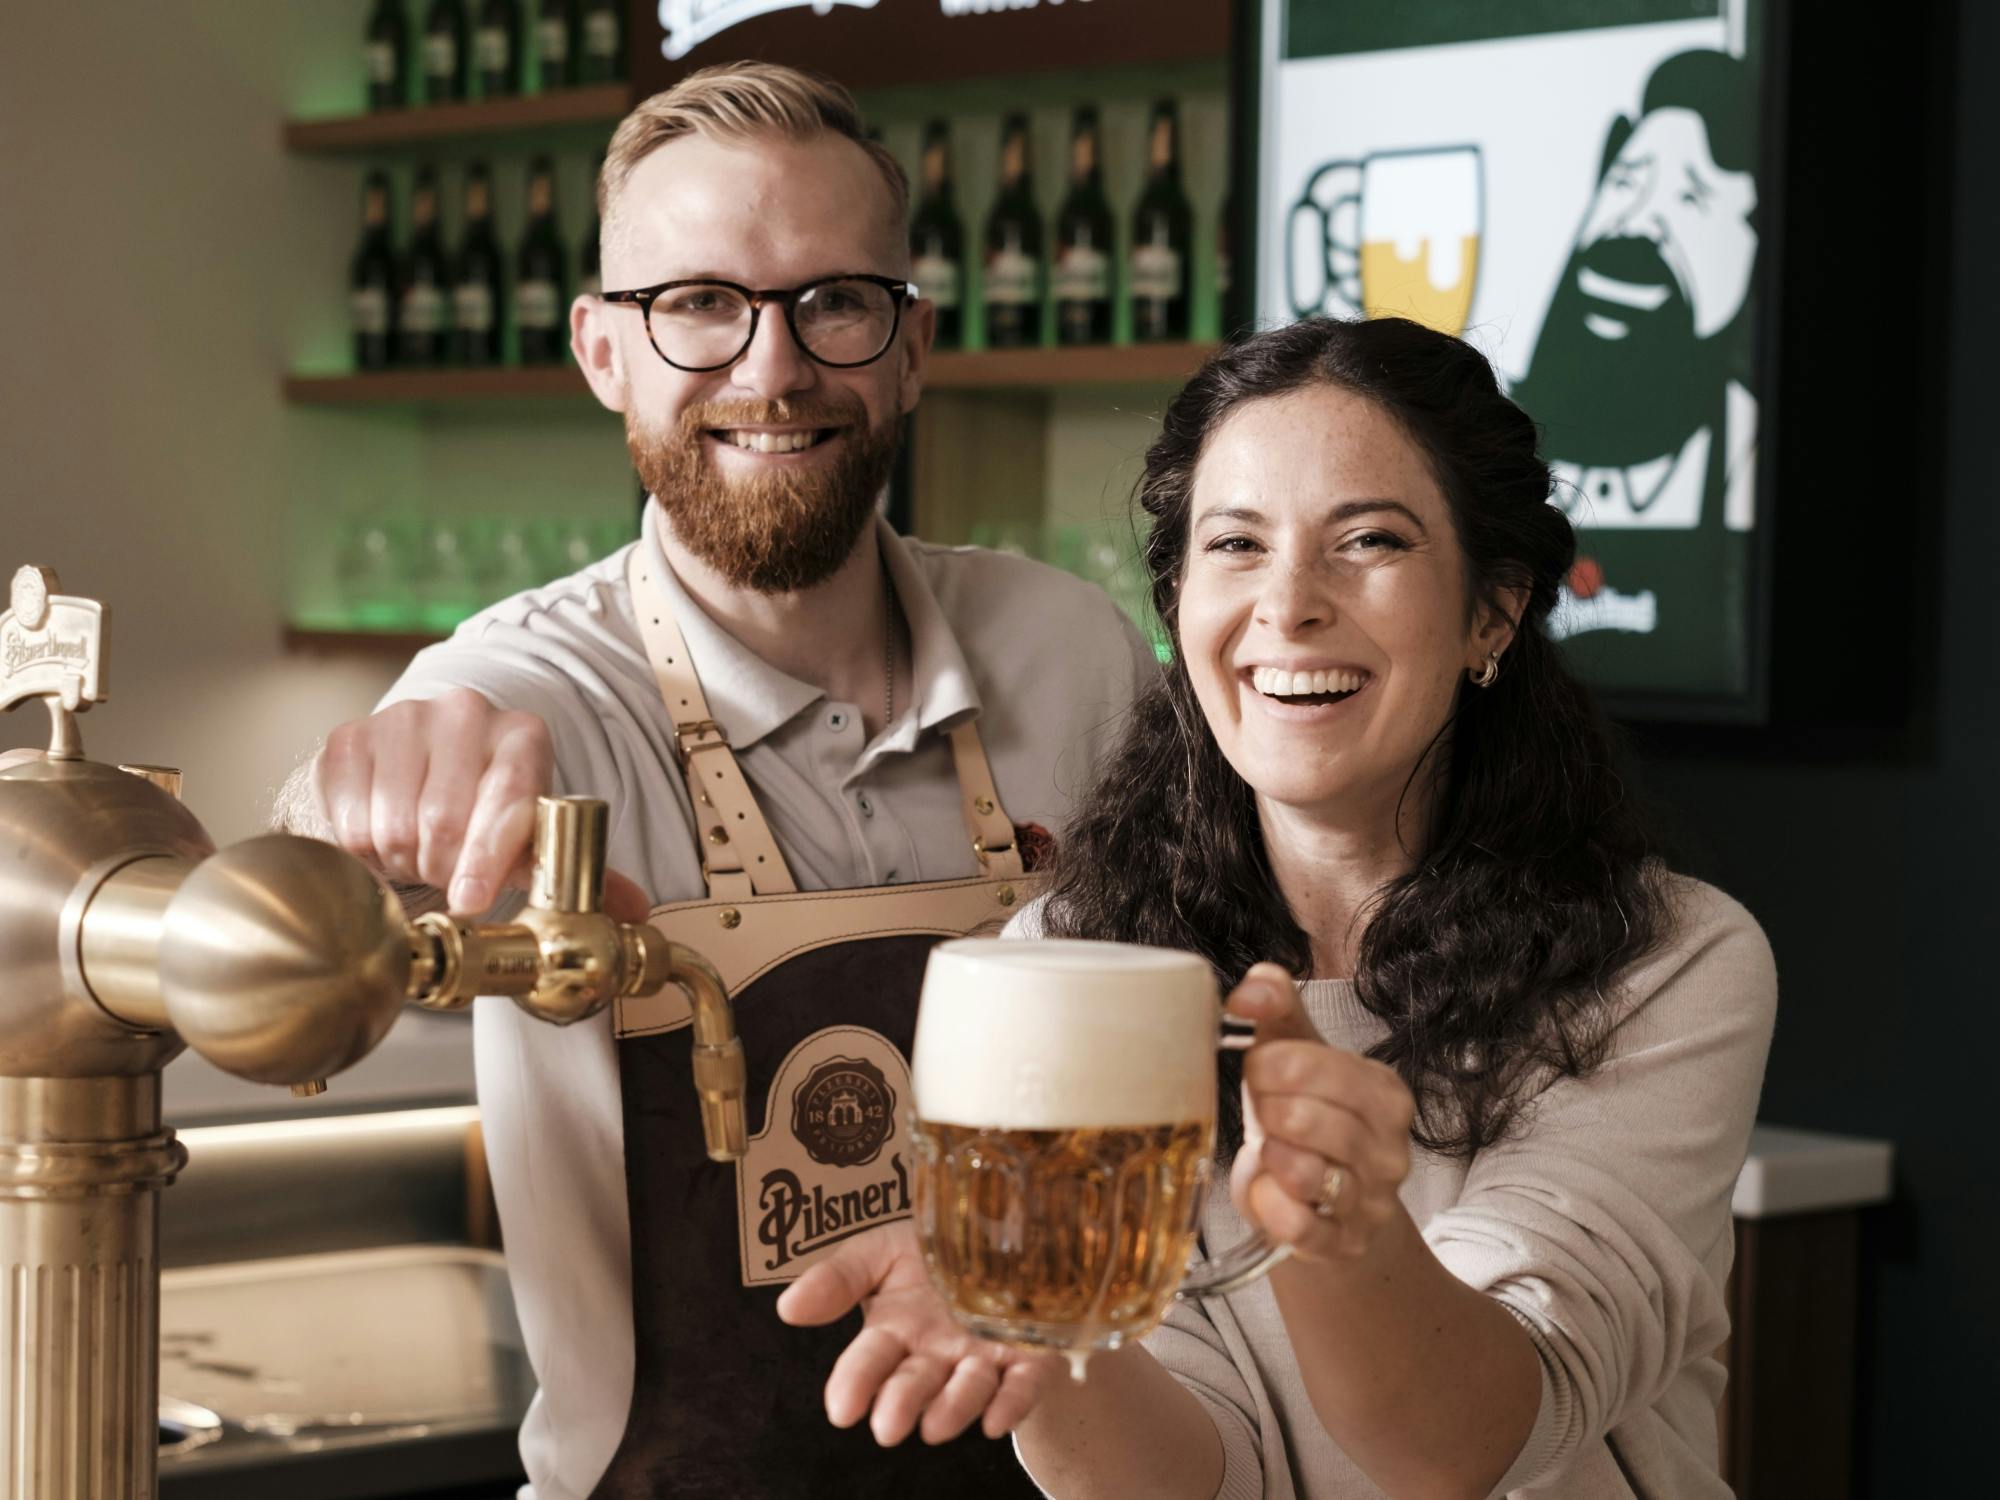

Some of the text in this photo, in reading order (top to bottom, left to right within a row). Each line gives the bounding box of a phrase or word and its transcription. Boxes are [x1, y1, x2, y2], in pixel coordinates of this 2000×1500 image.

[808, 1105, 884, 1124] 18 42
[758, 1168, 897, 1271] Pilsner
